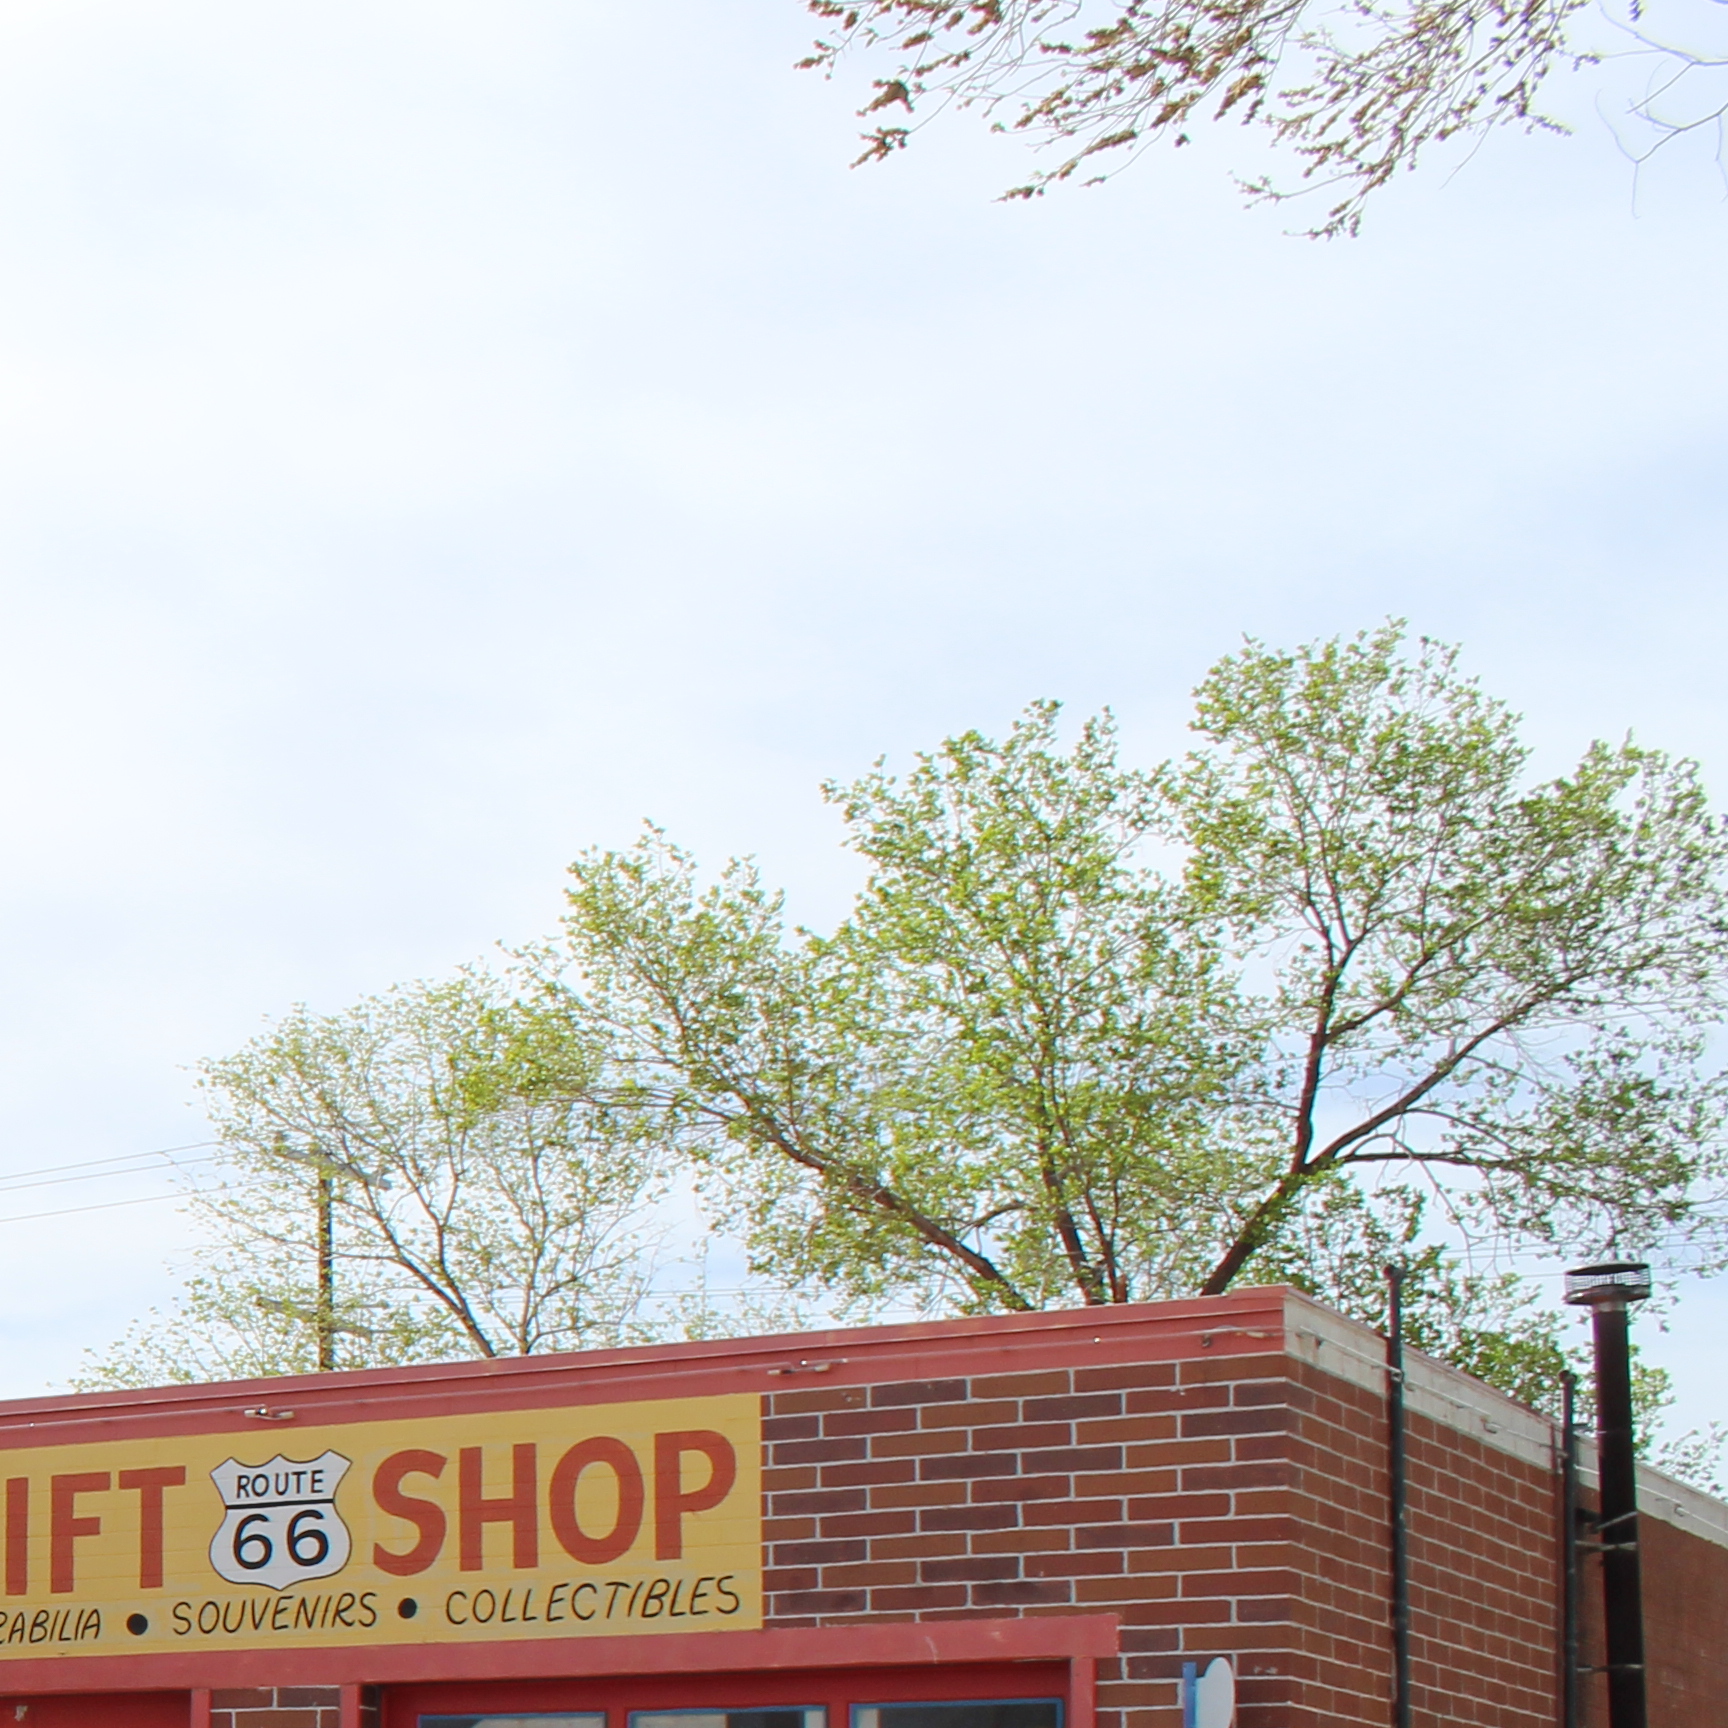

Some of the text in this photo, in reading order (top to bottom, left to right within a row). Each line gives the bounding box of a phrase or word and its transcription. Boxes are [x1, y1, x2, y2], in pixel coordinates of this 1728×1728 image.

[236, 1469, 325, 1499] ROUTE
[372, 1430, 737, 1577] SHOP
[232, 1509, 330, 1570] 66
[171, 1591, 378, 1636] SOUVENIRS
[445, 1574, 741, 1626] COLLECTIBLES
